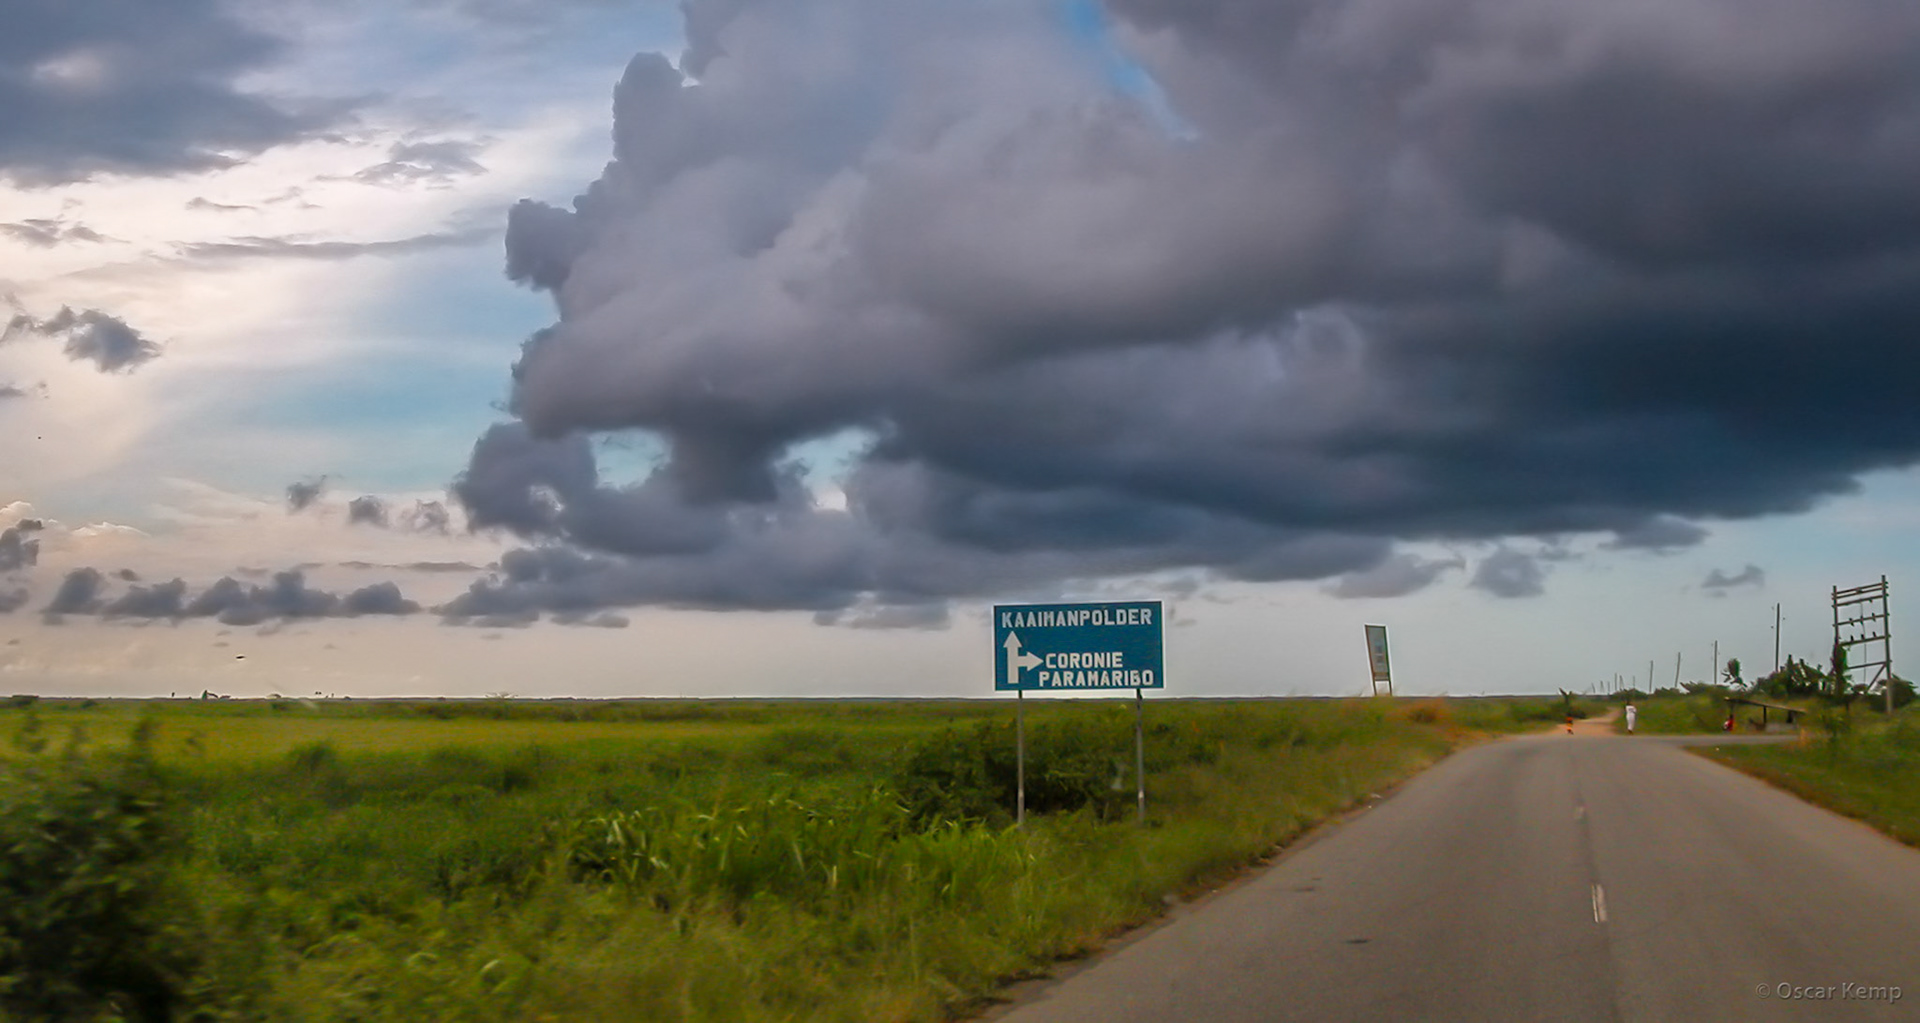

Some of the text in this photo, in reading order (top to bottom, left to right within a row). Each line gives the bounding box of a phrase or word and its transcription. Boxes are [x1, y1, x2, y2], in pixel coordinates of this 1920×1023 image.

[1002, 608, 1152, 628] KAAIMANPOLDER
[1045, 652, 1123, 669] CORONIE
[1039, 669, 1154, 687] PARAMARIBO
